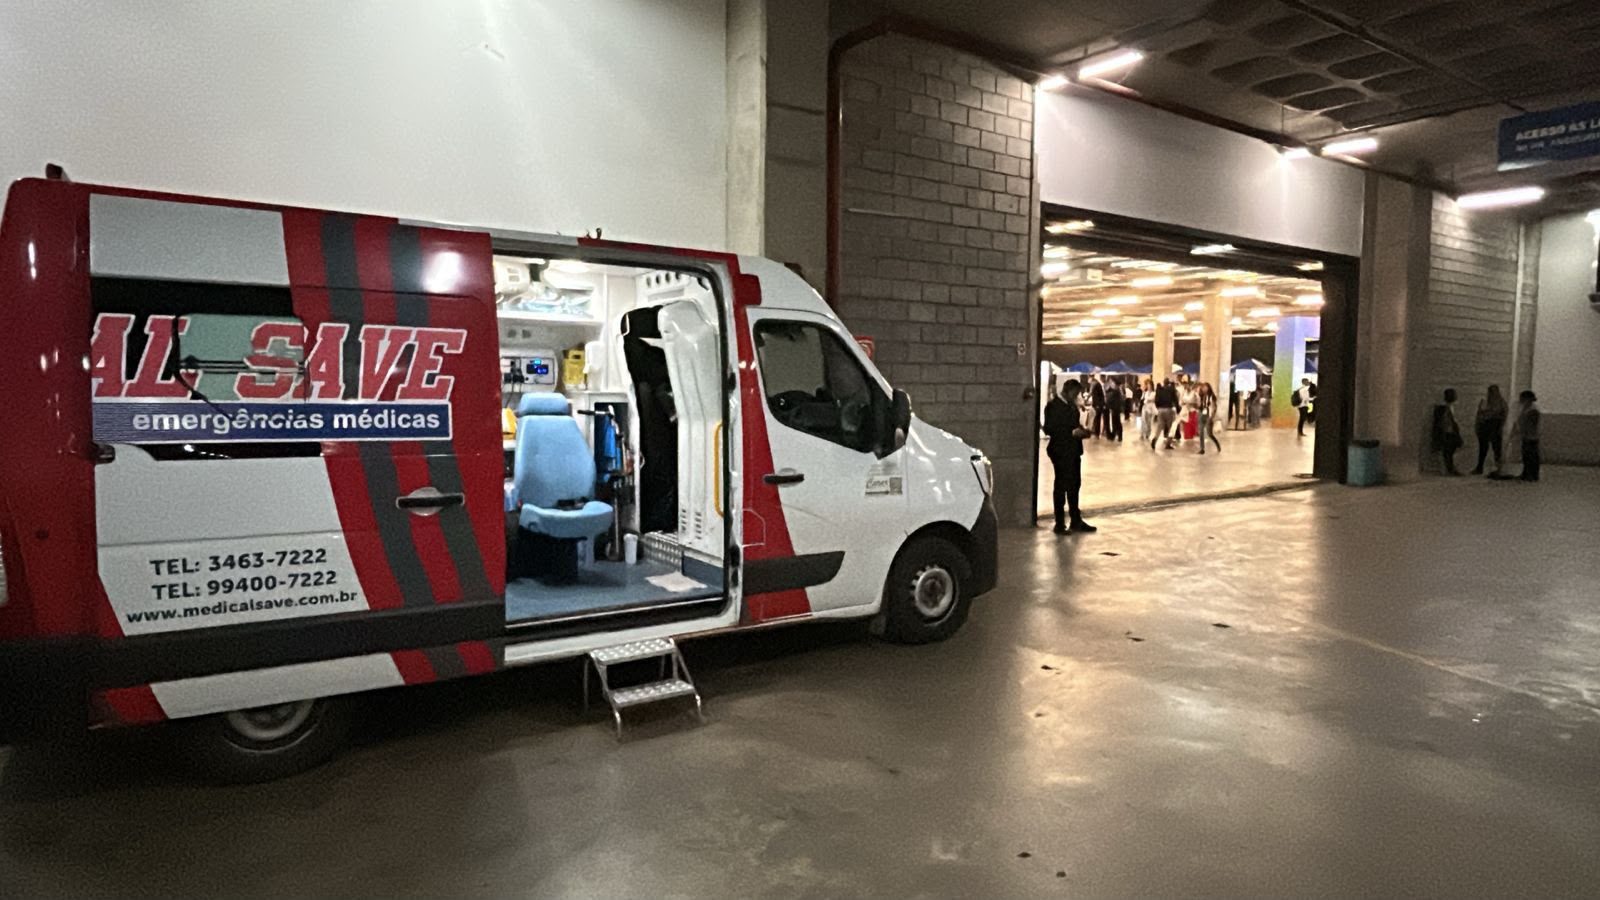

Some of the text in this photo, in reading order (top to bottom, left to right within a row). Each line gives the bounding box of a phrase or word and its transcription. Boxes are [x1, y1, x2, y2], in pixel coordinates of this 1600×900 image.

[233, 322, 468, 401] SAVE
[132, 408, 440, 434] emergências médicas
[150, 548, 327, 576] TEL: 3463-7222
[152, 570, 337, 600] TEL: 99400-7222
[126, 591, 358, 623] www.medicalsave.com.br
